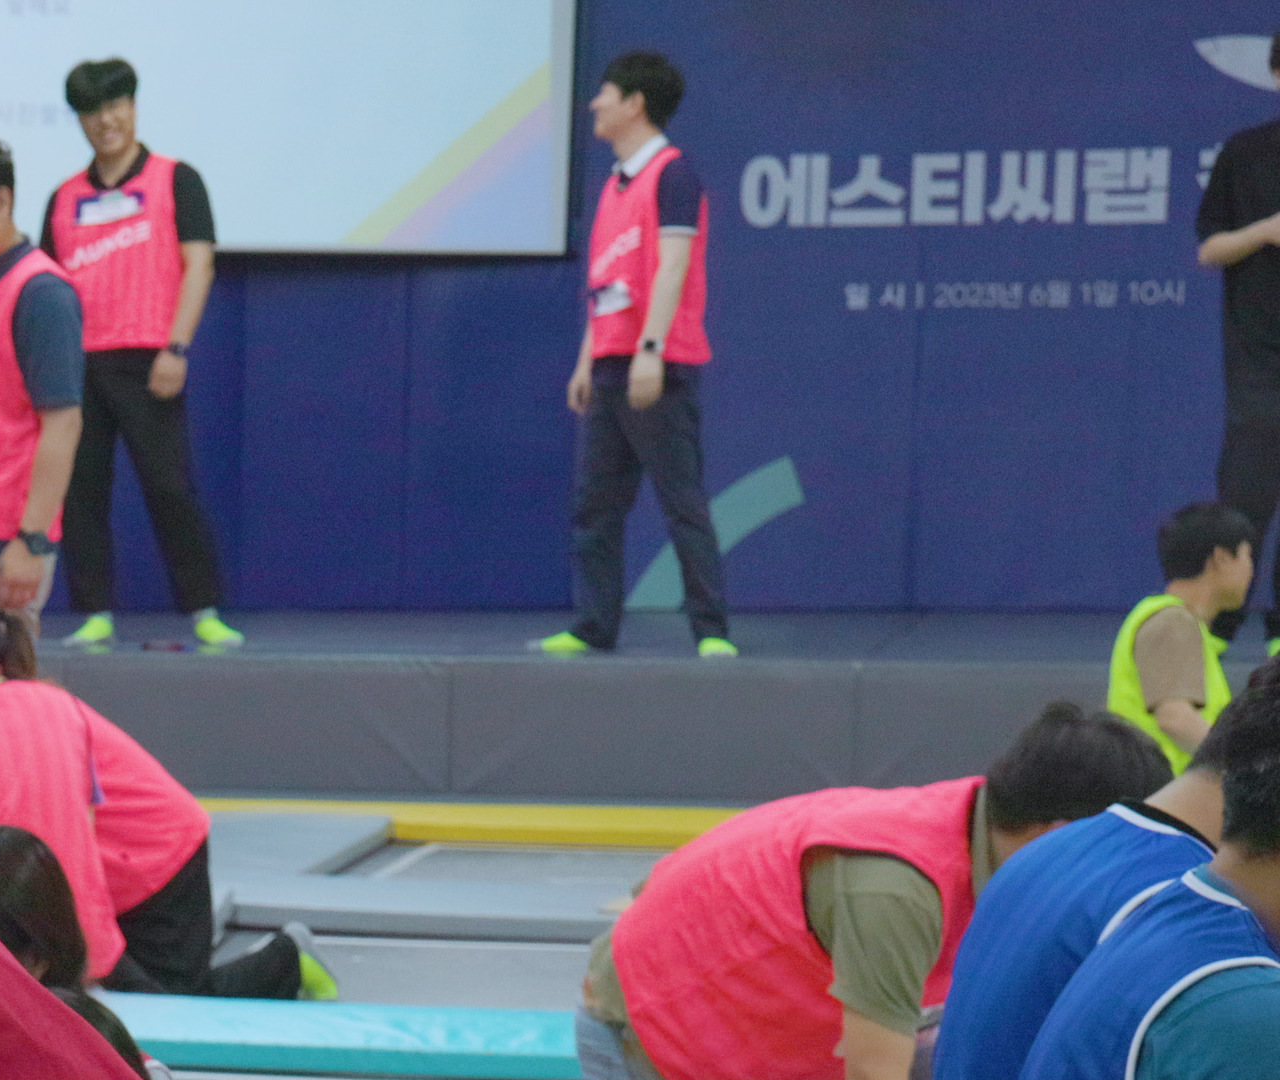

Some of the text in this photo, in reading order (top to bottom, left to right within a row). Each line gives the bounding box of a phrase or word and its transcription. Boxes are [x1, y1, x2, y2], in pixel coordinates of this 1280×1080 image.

[740, 147, 1171, 227] 에스티씨랩
[934, 281, 1023, 309] 2023년
[1029, 280, 1072, 309] 6월
[1083, 280, 1119, 308] 1일
[1127, 279, 1187, 307] 10시
